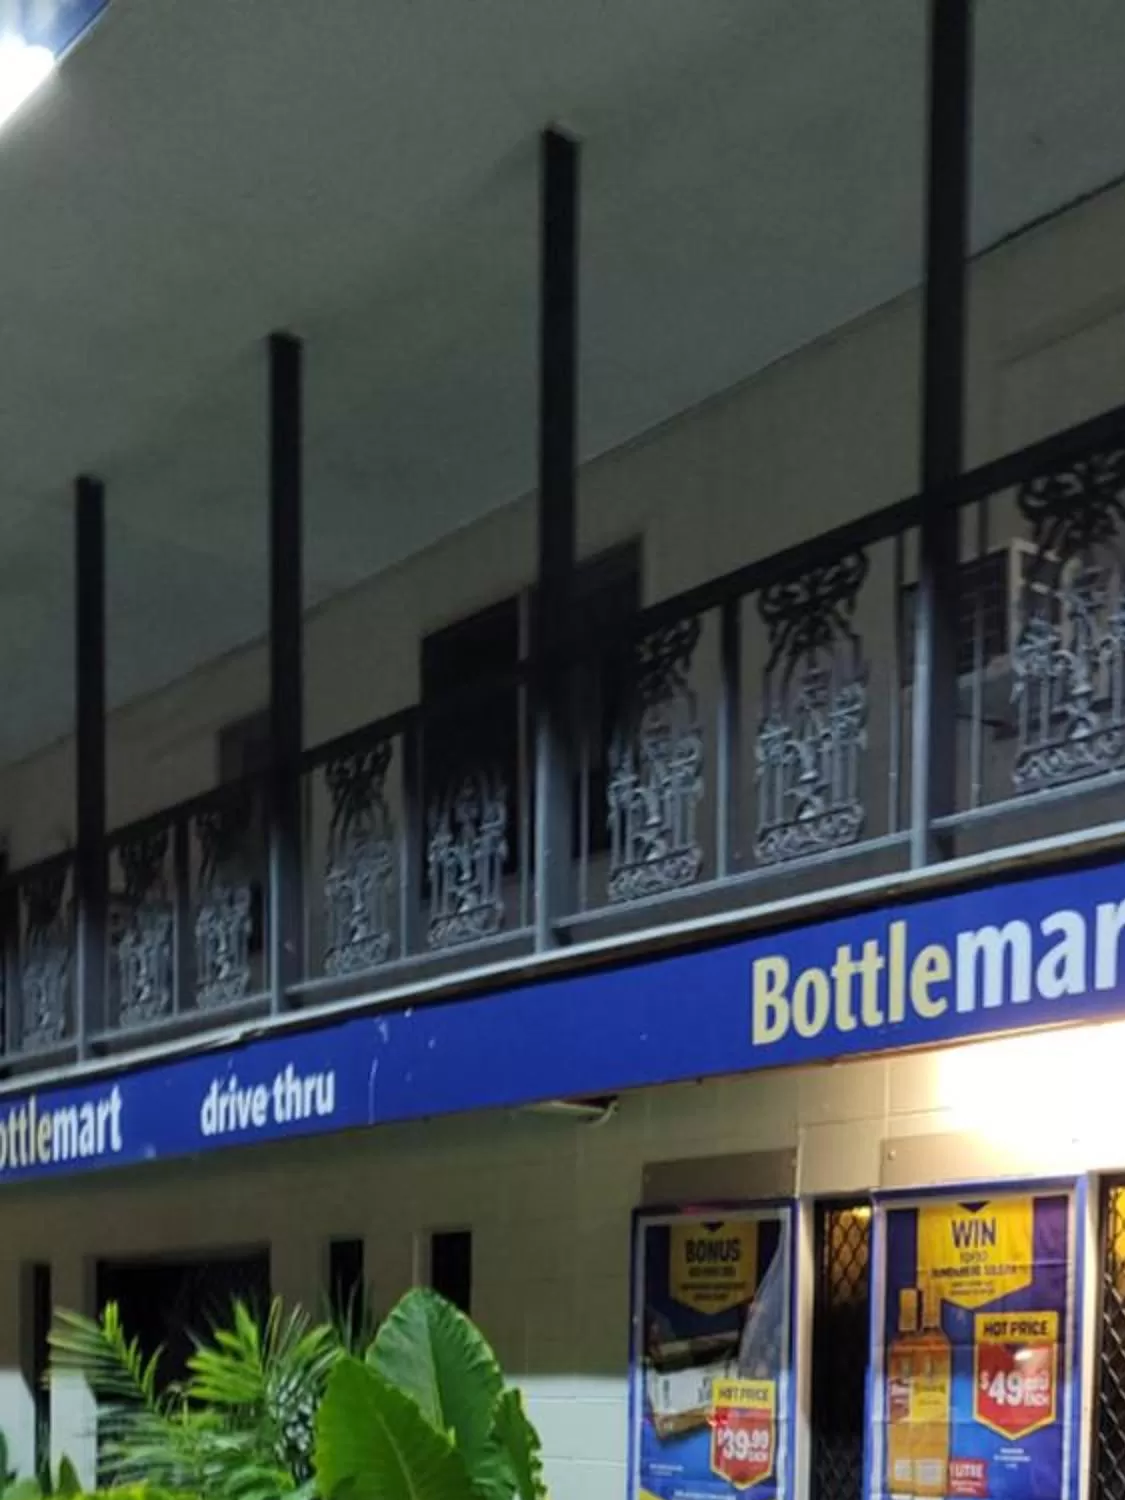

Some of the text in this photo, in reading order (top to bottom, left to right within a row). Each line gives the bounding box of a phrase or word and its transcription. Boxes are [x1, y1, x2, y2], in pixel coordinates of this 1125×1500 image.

[0, 1062, 336, 1171] ottlemart drive thru
[951, 1218, 997, 1248] WIN
[684, 1237, 741, 1264] BONUS
[983, 1320, 1048, 1337] HOT PRICE
